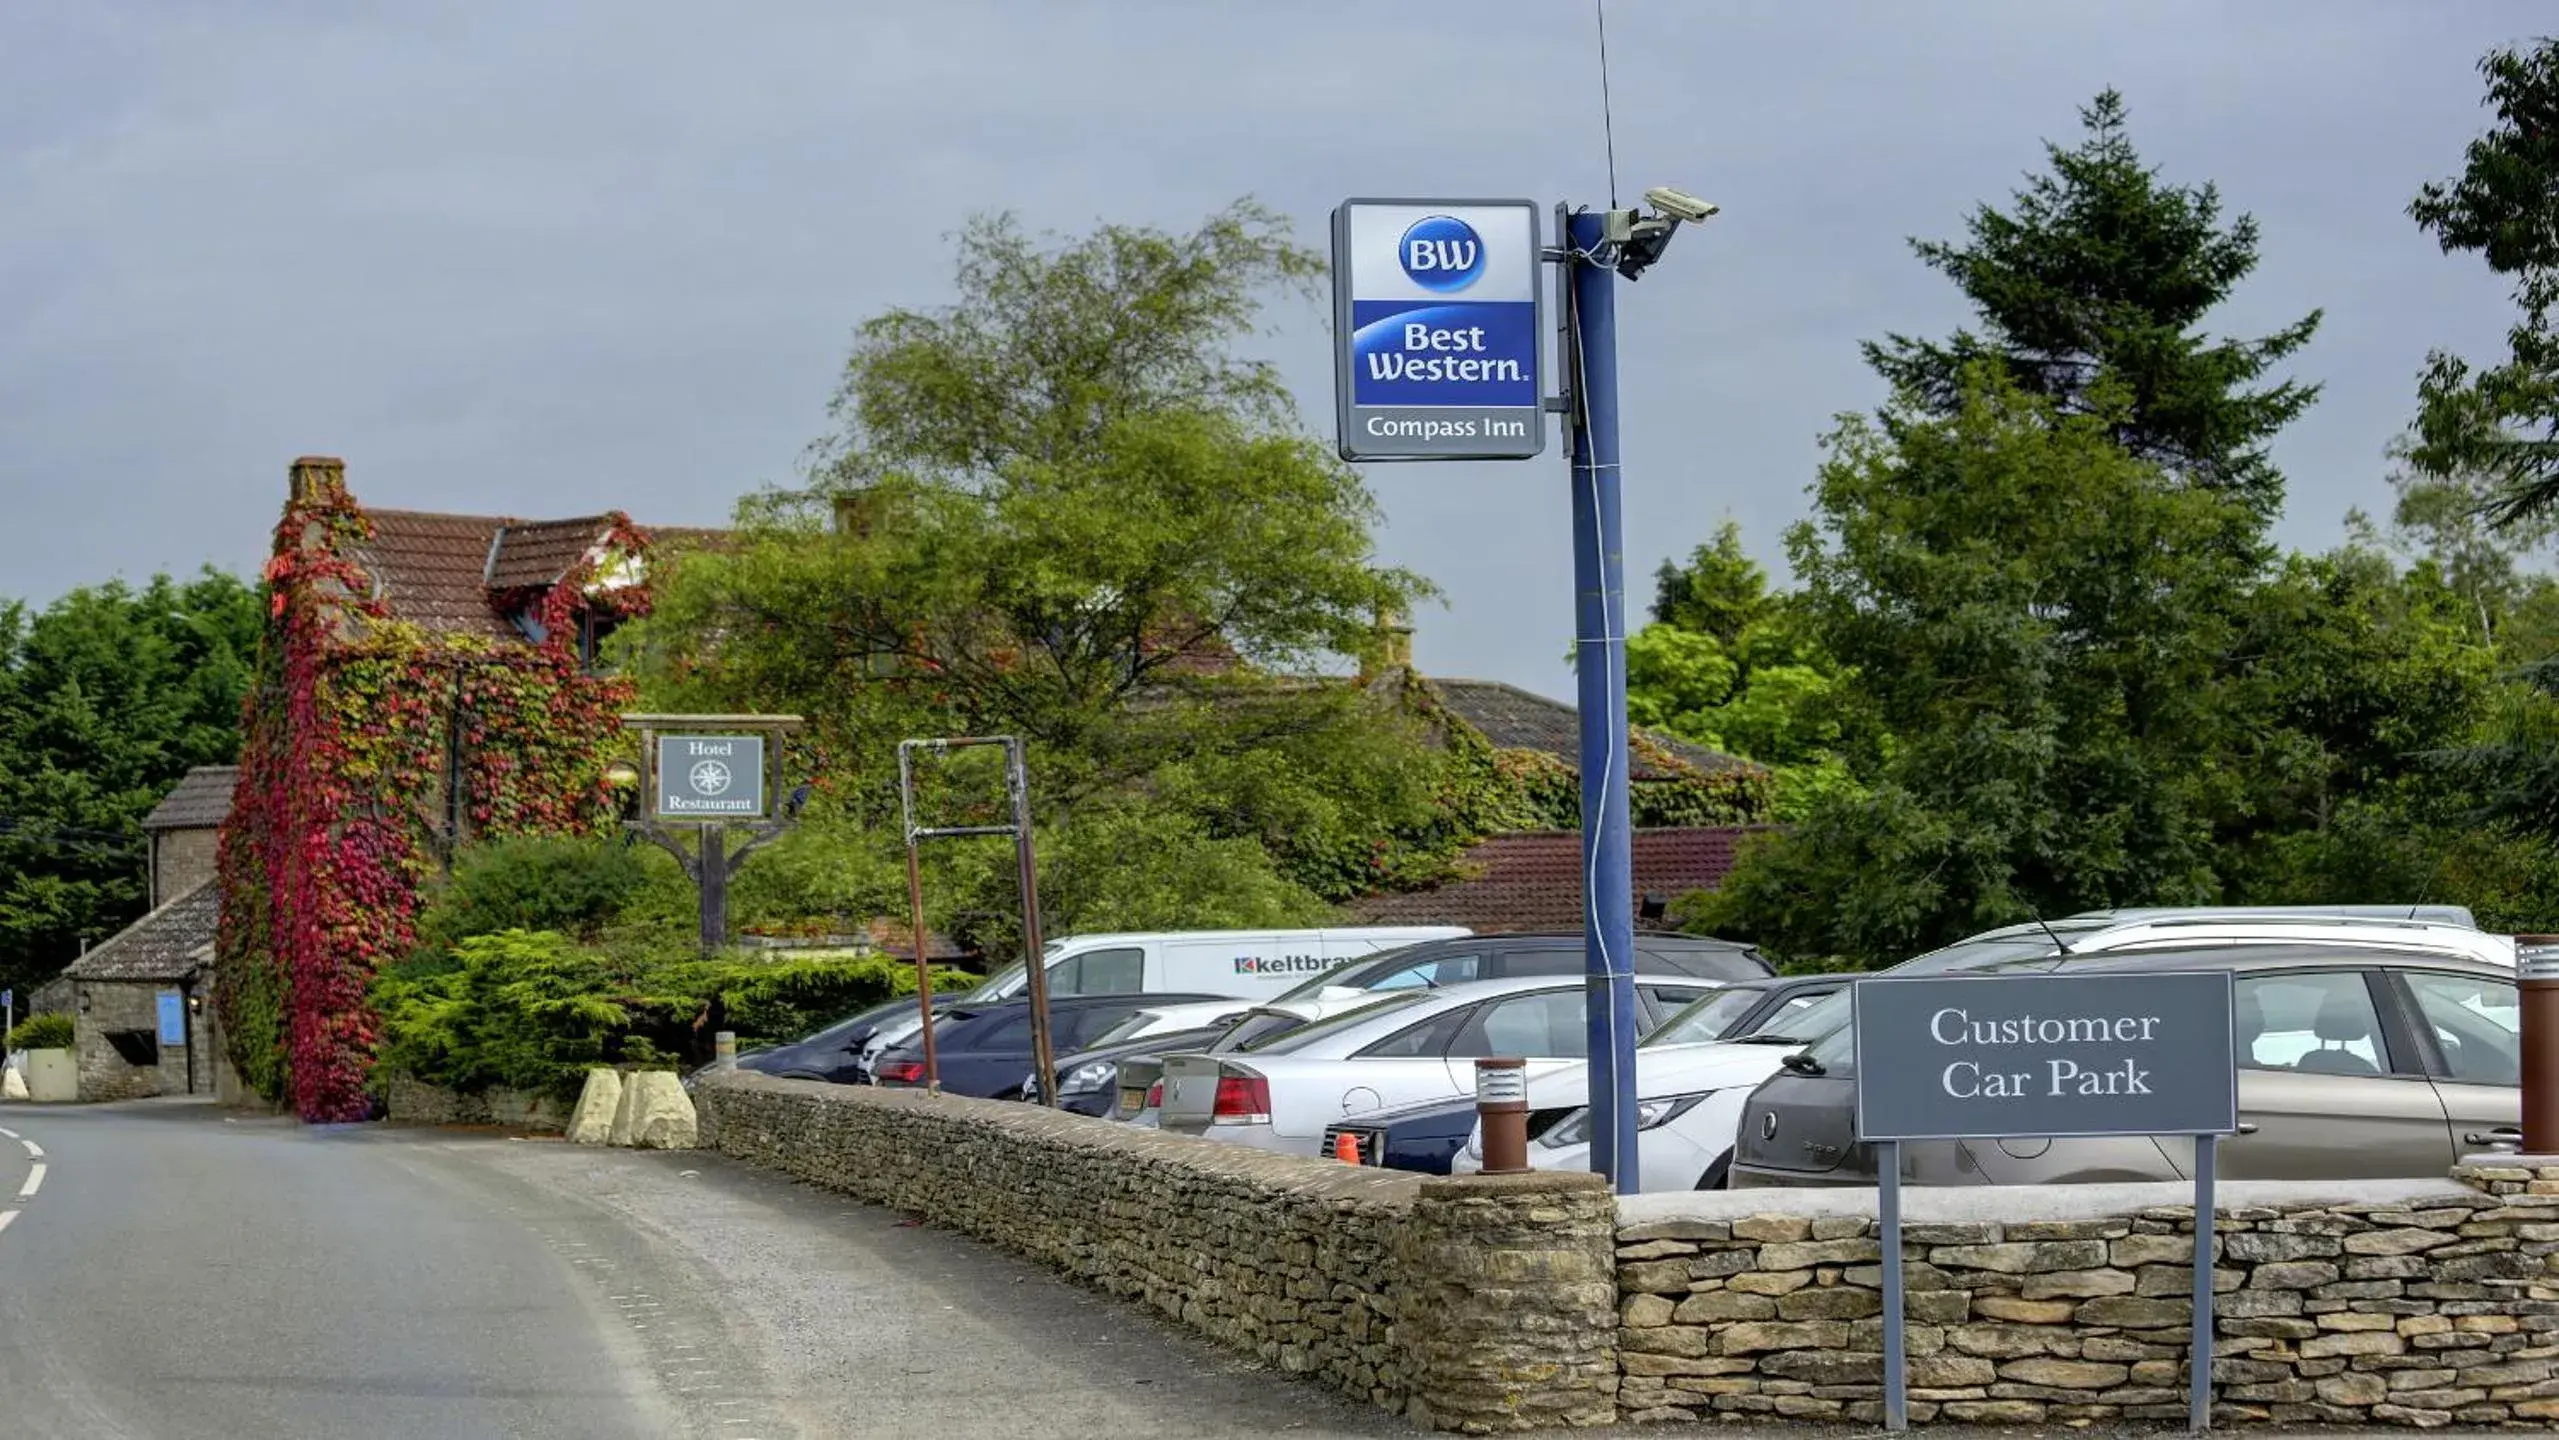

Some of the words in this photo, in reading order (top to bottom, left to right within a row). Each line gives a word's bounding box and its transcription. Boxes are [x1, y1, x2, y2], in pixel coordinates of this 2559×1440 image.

[1409, 239, 1476, 271] BW
[1404, 323, 1486, 352] Best
[1367, 417, 1476, 441] Compass
[1484, 418, 1525, 437] Inn
[689, 741, 732, 756] Hotel
[669, 795, 751, 810] Restaurant
[1256, 955, 1353, 973] keltbra
[1930, 1008, 2160, 1045] Customer
[1942, 1061, 2031, 1098] Car
[2046, 1058, 2152, 1096] Park
